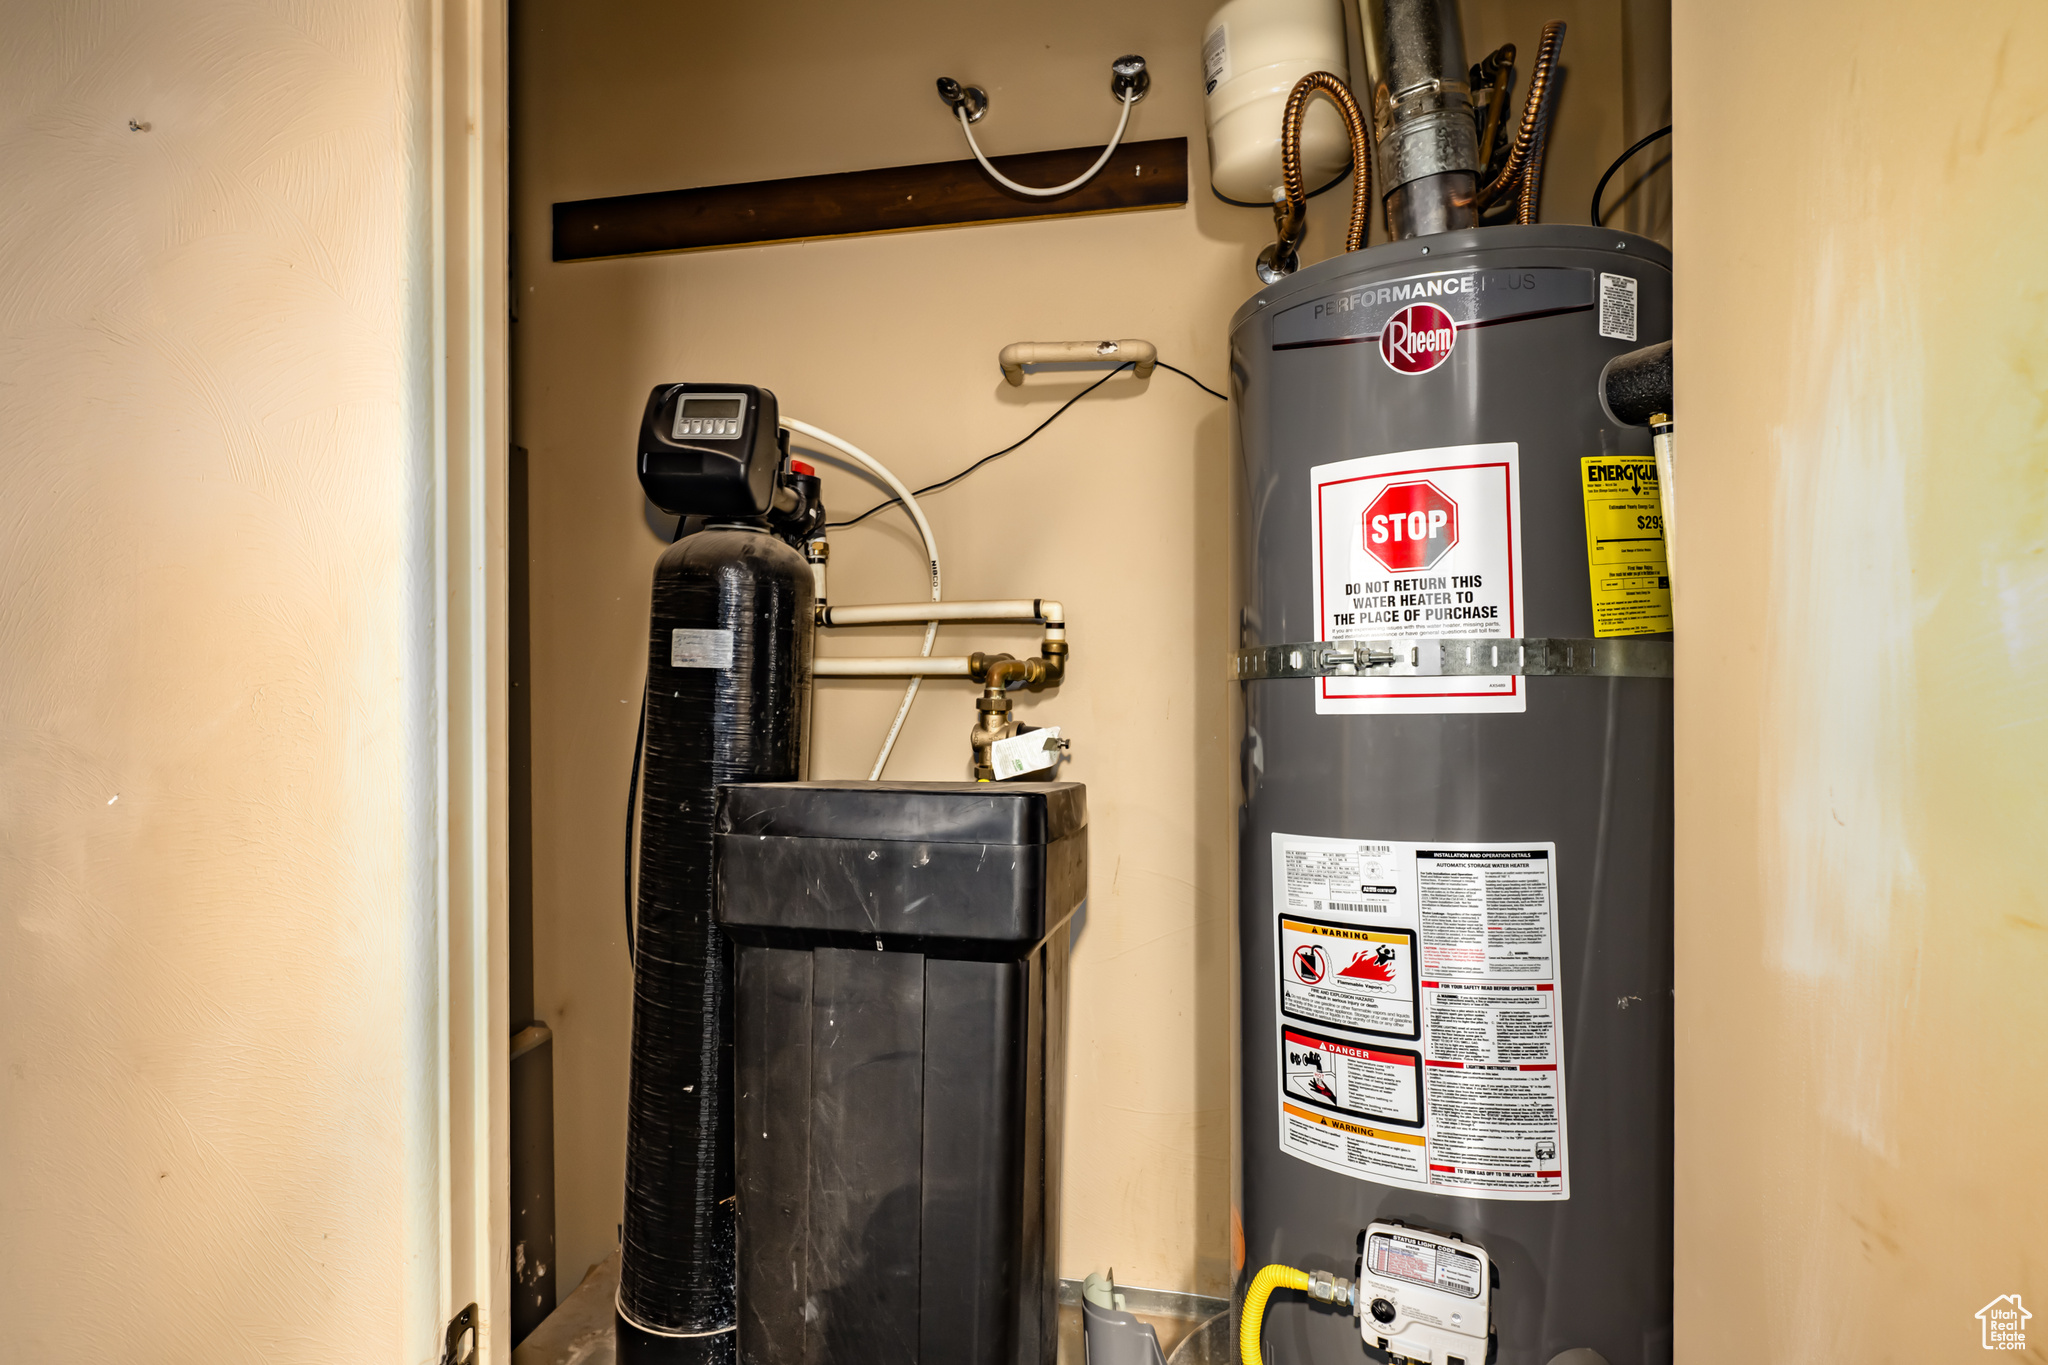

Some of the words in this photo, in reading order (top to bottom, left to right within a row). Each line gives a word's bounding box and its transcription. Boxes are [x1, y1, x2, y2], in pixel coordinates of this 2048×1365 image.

[1315, 276, 1474, 319] PERFORMANCE
[1389, 307, 1451, 364] Rheem
[1372, 510, 1448, 544] STOP
[1346, 583, 1361, 595] DO
[1366, 581, 1389, 593] NOT
[1394, 577, 1446, 592] RETURN
[1451, 575, 1482, 588] THIS
[1353, 595, 1395, 609] WATER
[1401, 592, 1451, 607] HEATER
[1456, 591, 1474, 604] TO
[1334, 613, 1355, 625] THE
[1360, 611, 1399, 623] PLACE
[1404, 610, 1420, 621] OF
[1426, 606, 1498, 620] PURCHASE
[1322, 928, 1368, 940] WARNING
[1337, 980, 1363, 988] Flammable
[1329, 1044, 1369, 1058] DANGER
[1332, 1121, 1374, 1136] WARNING
[1393, 1236, 1416, 1244] STATUS
[1418, 1241, 1436, 1249] LIGHT
[1437, 1246, 1455, 1254] CODE
